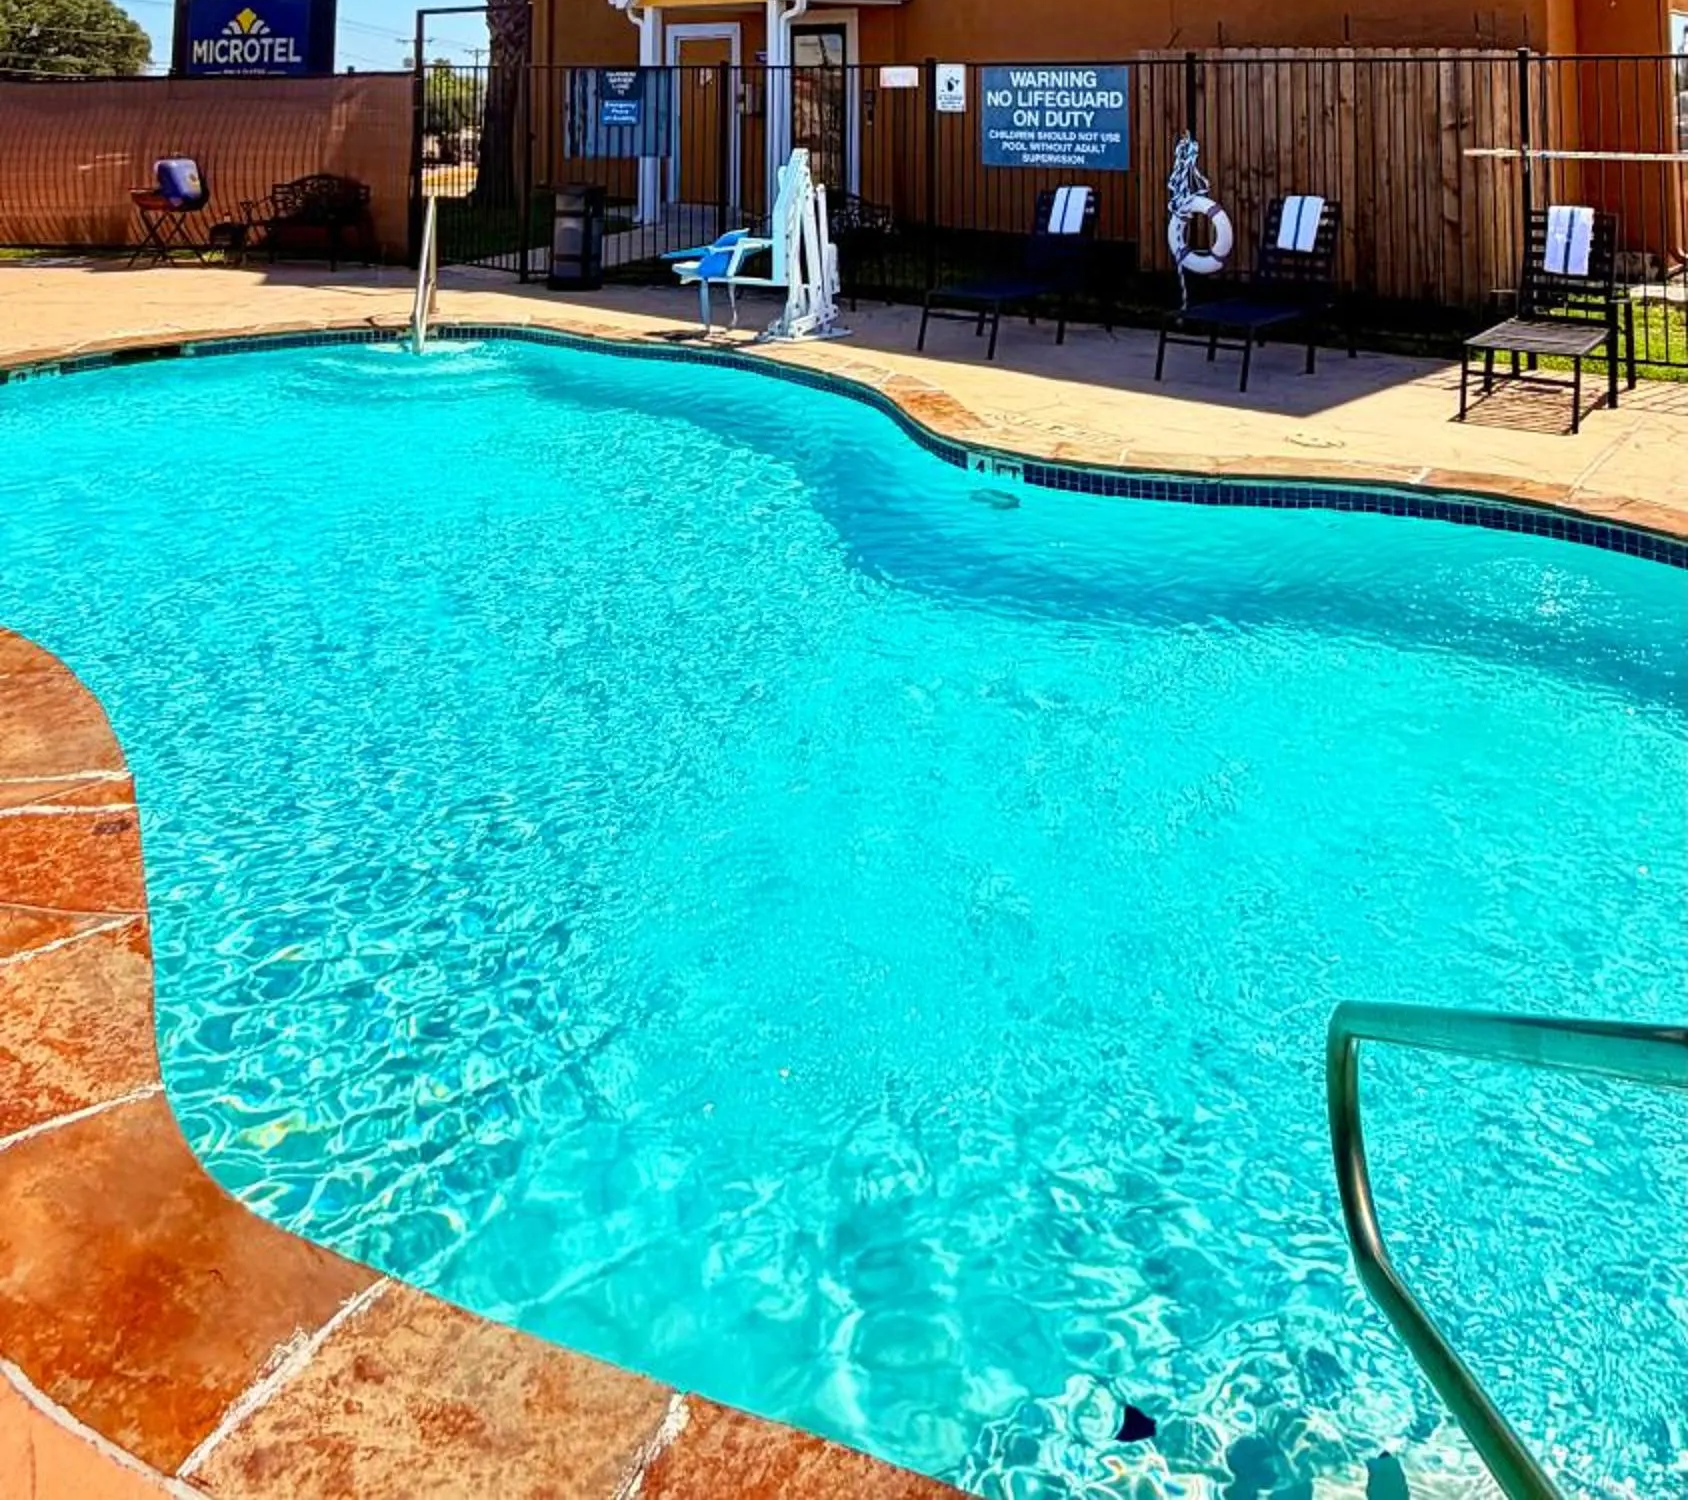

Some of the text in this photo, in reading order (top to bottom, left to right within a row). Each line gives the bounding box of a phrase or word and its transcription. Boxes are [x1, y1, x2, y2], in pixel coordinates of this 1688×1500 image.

[193, 37, 302, 64] MICROTEL
[1009, 71, 1097, 88] WARNING
[987, 90, 1123, 108] NO LIFEGUARD
[1013, 110, 1095, 128] ON DUTY
[989, 130, 1121, 143] CHILDREN SHOULD NOT USE
[1002, 142, 1106, 154] POOL WITHOUT ADULT
